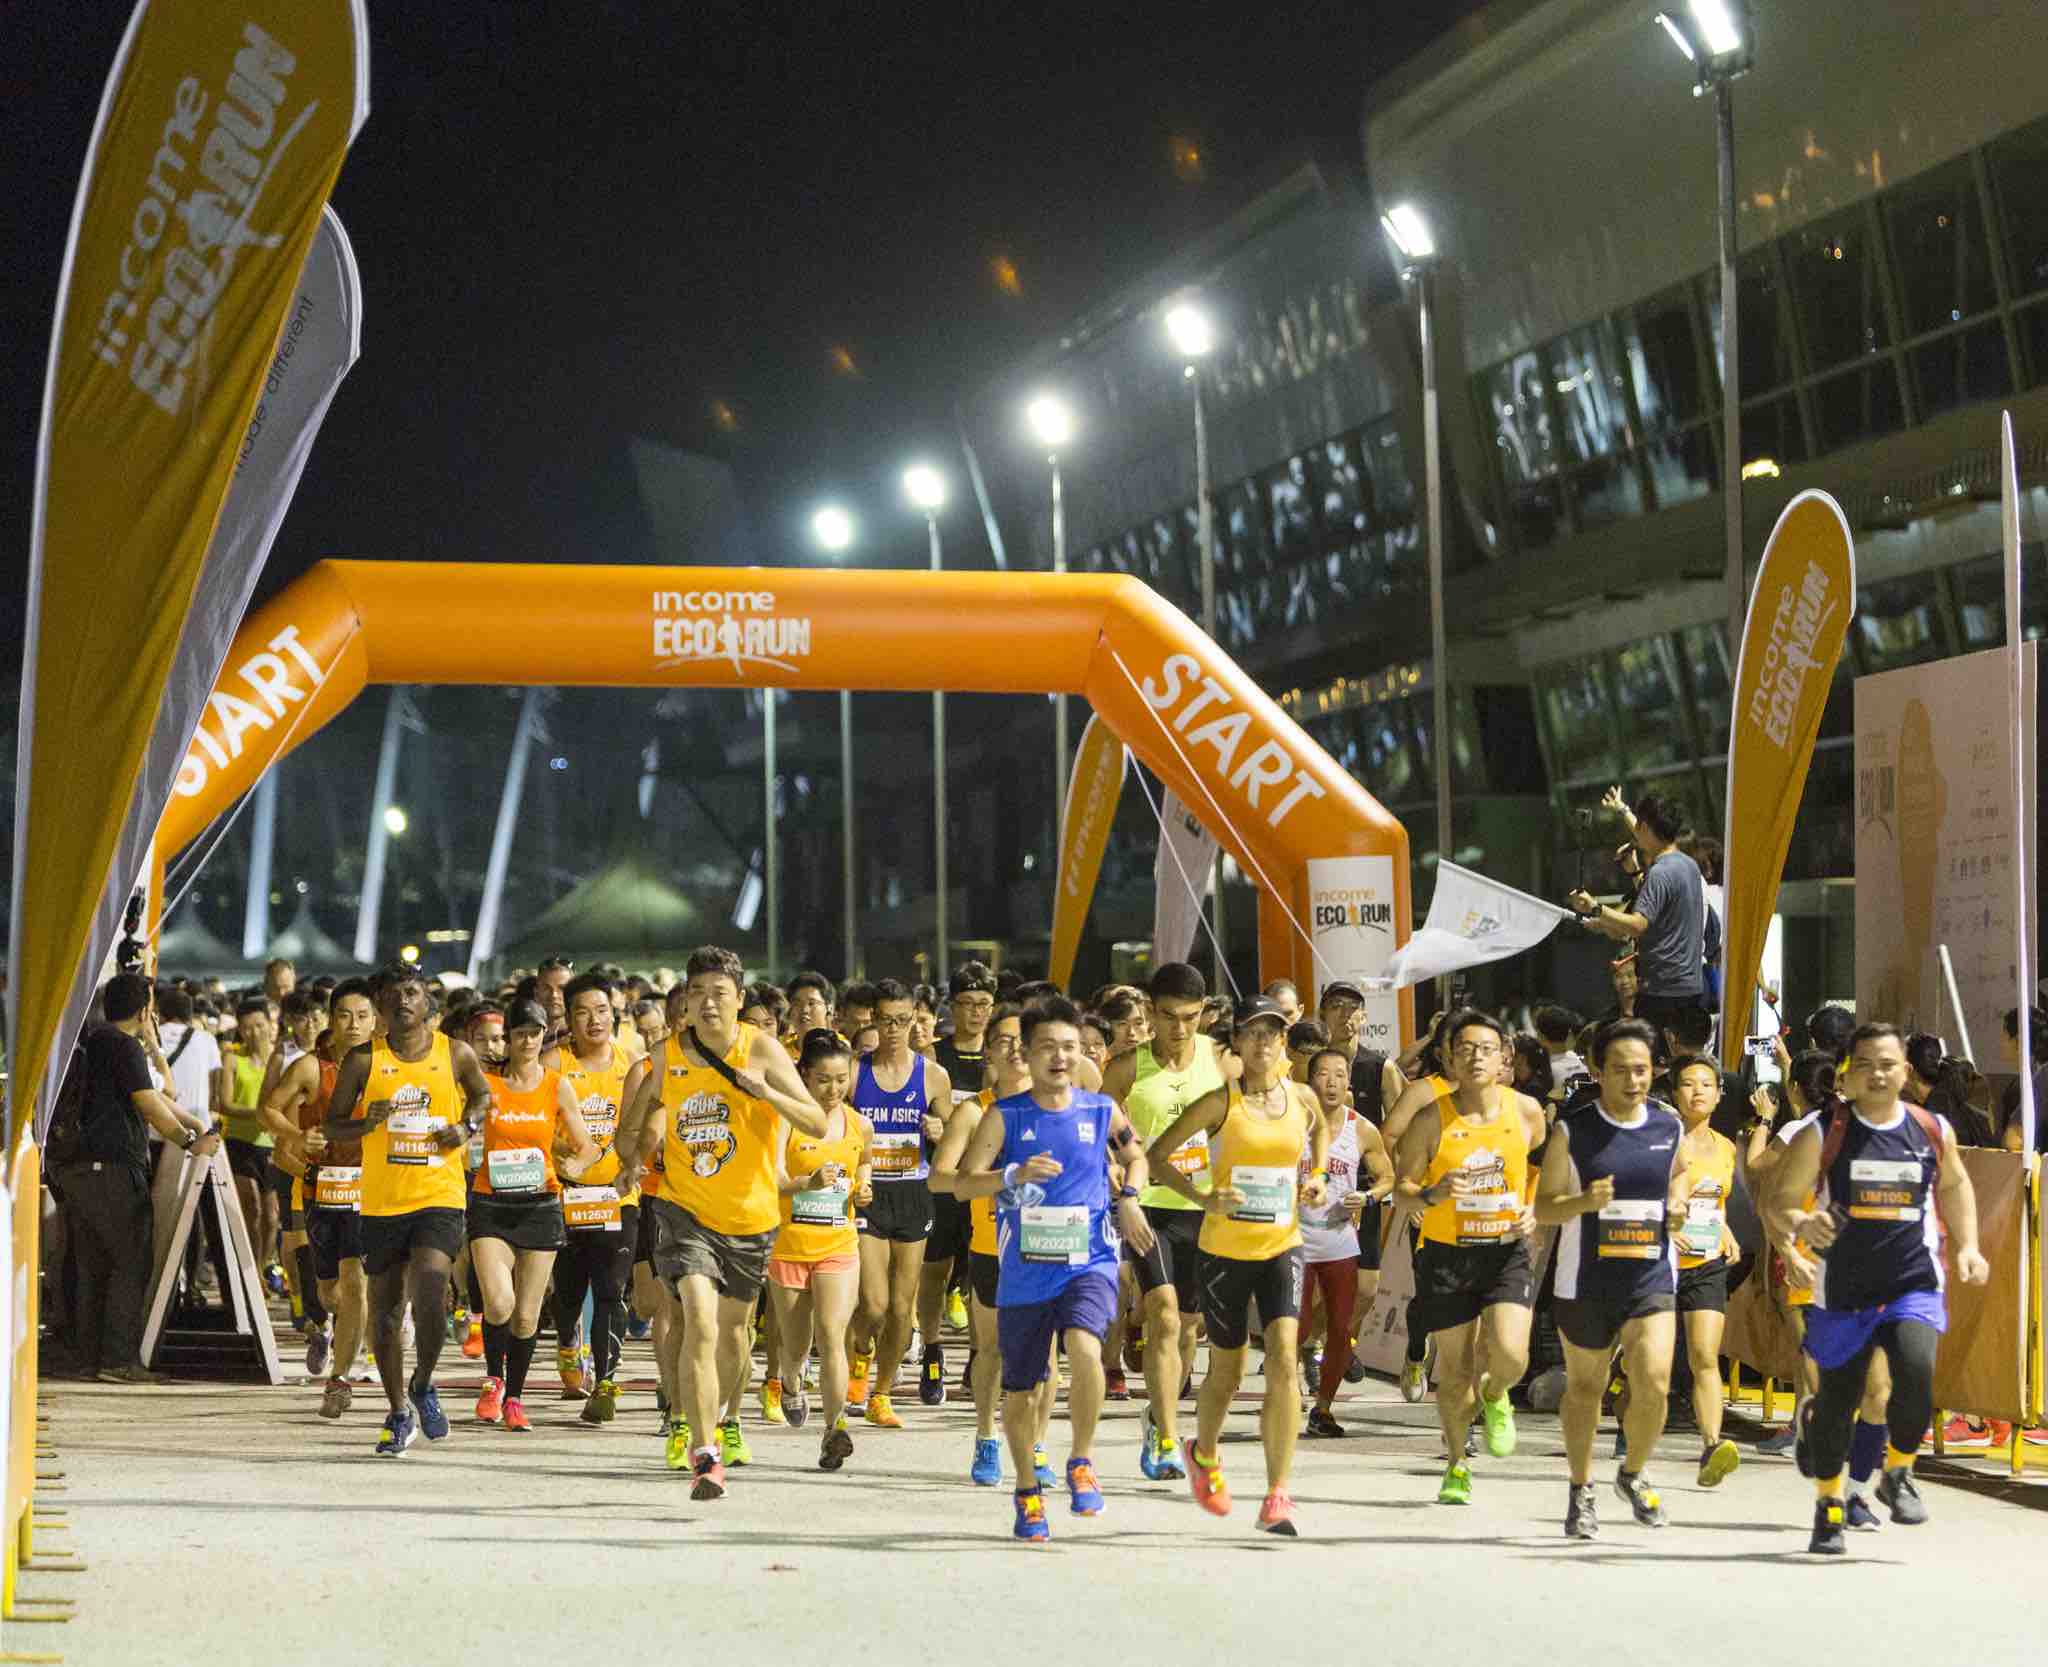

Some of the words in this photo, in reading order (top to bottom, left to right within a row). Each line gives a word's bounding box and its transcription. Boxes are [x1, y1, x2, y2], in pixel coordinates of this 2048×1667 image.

[201, 22, 297, 203] RUN
[91, 76, 209, 368] income
[652, 591, 776, 613] income
[653, 618, 717, 657] ECO
[743, 618, 812, 657] RUN
[1751, 583, 1795, 728] income
[1141, 654, 1328, 828] START
[1316, 905, 1346, 927] ECO
[1361, 903, 1392, 924] RUN
[860, 1107, 888, 1122] TEAM
[891, 1108, 921, 1124] ASICS
